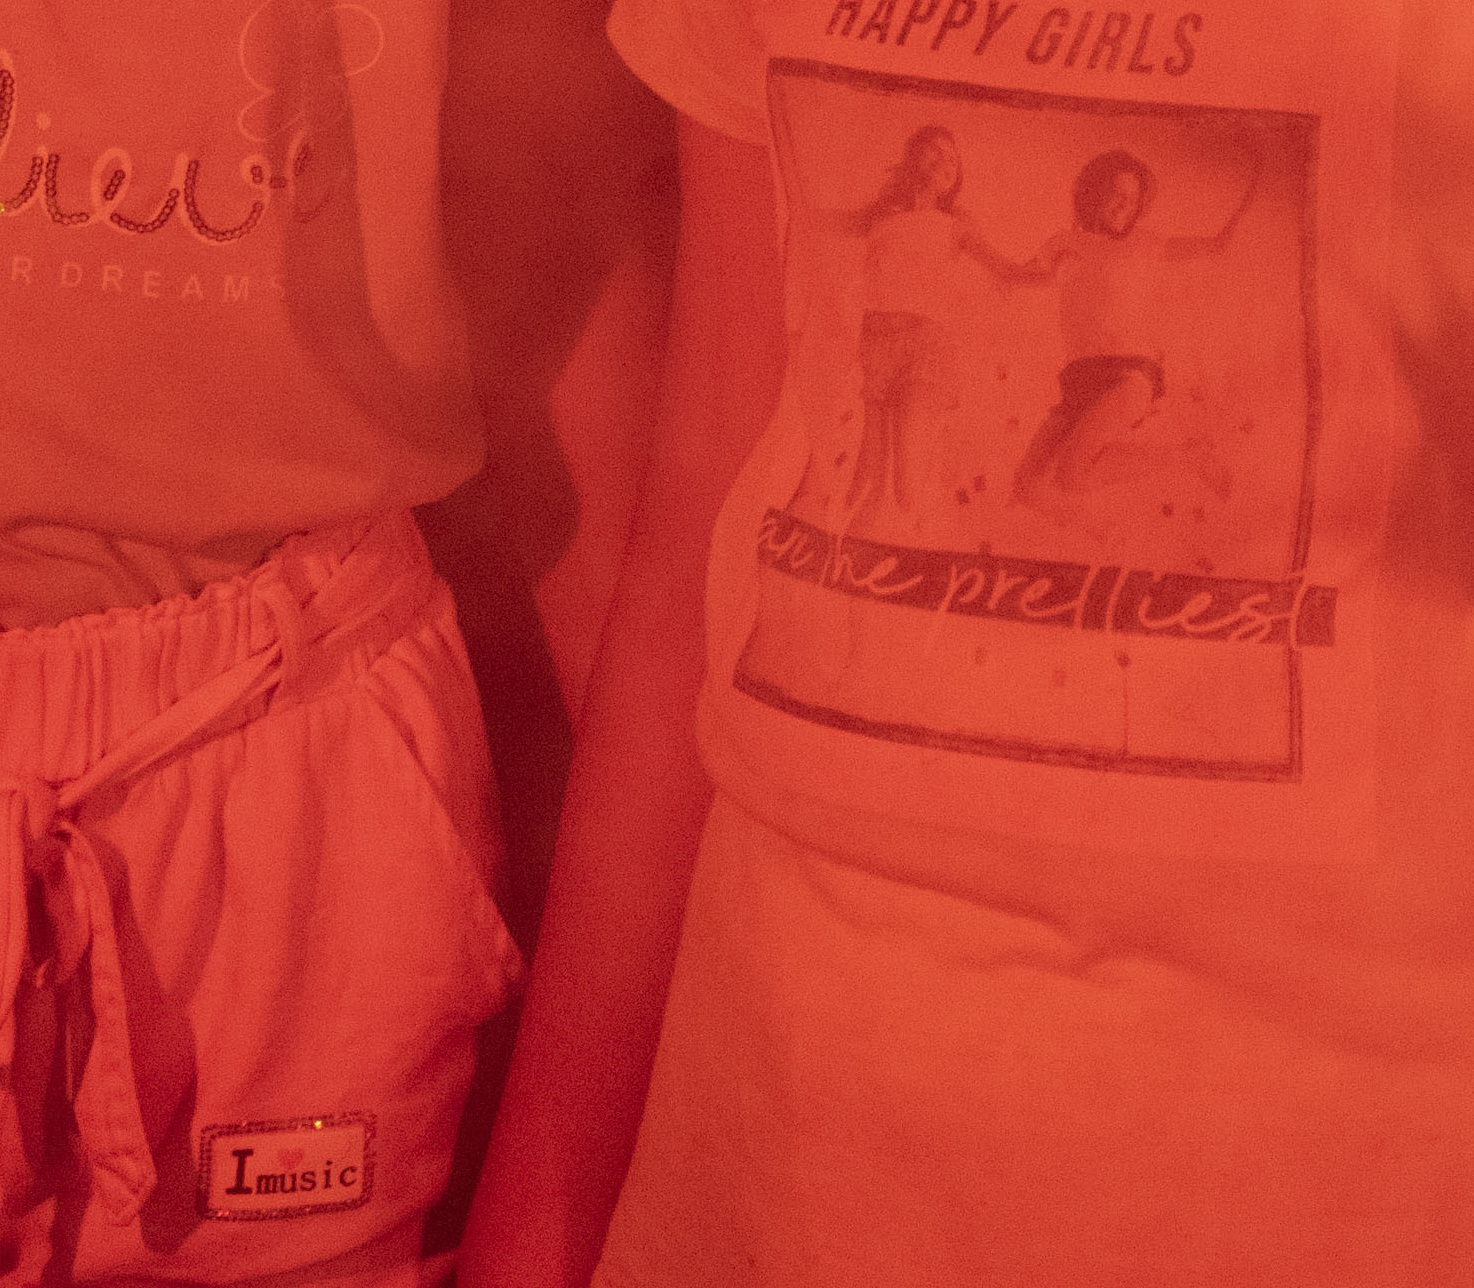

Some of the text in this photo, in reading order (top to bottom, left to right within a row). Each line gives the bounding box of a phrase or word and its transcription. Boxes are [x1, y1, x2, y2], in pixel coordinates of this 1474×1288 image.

[1026, 6, 1203, 76] GIRLS
[225, 1148, 358, 1195] I music
